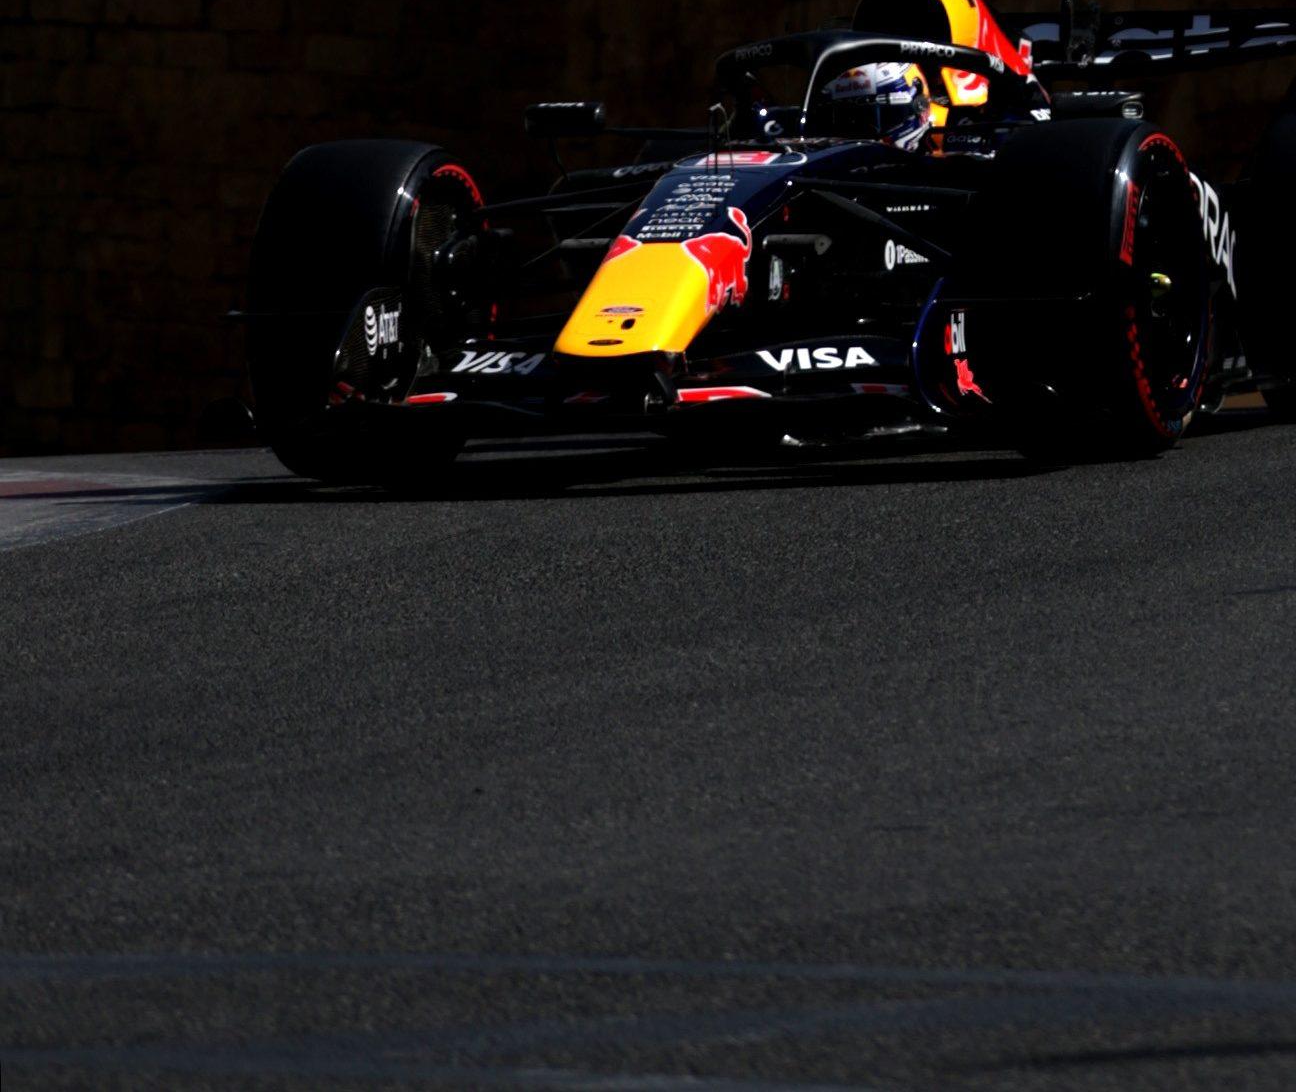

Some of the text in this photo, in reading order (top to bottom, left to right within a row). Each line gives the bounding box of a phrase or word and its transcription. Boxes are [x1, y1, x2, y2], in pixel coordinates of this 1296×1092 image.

[900, 42, 956, 58] PRYPCO
[450, 350, 547, 375] VISA
[755, 347, 880, 372] VISA
